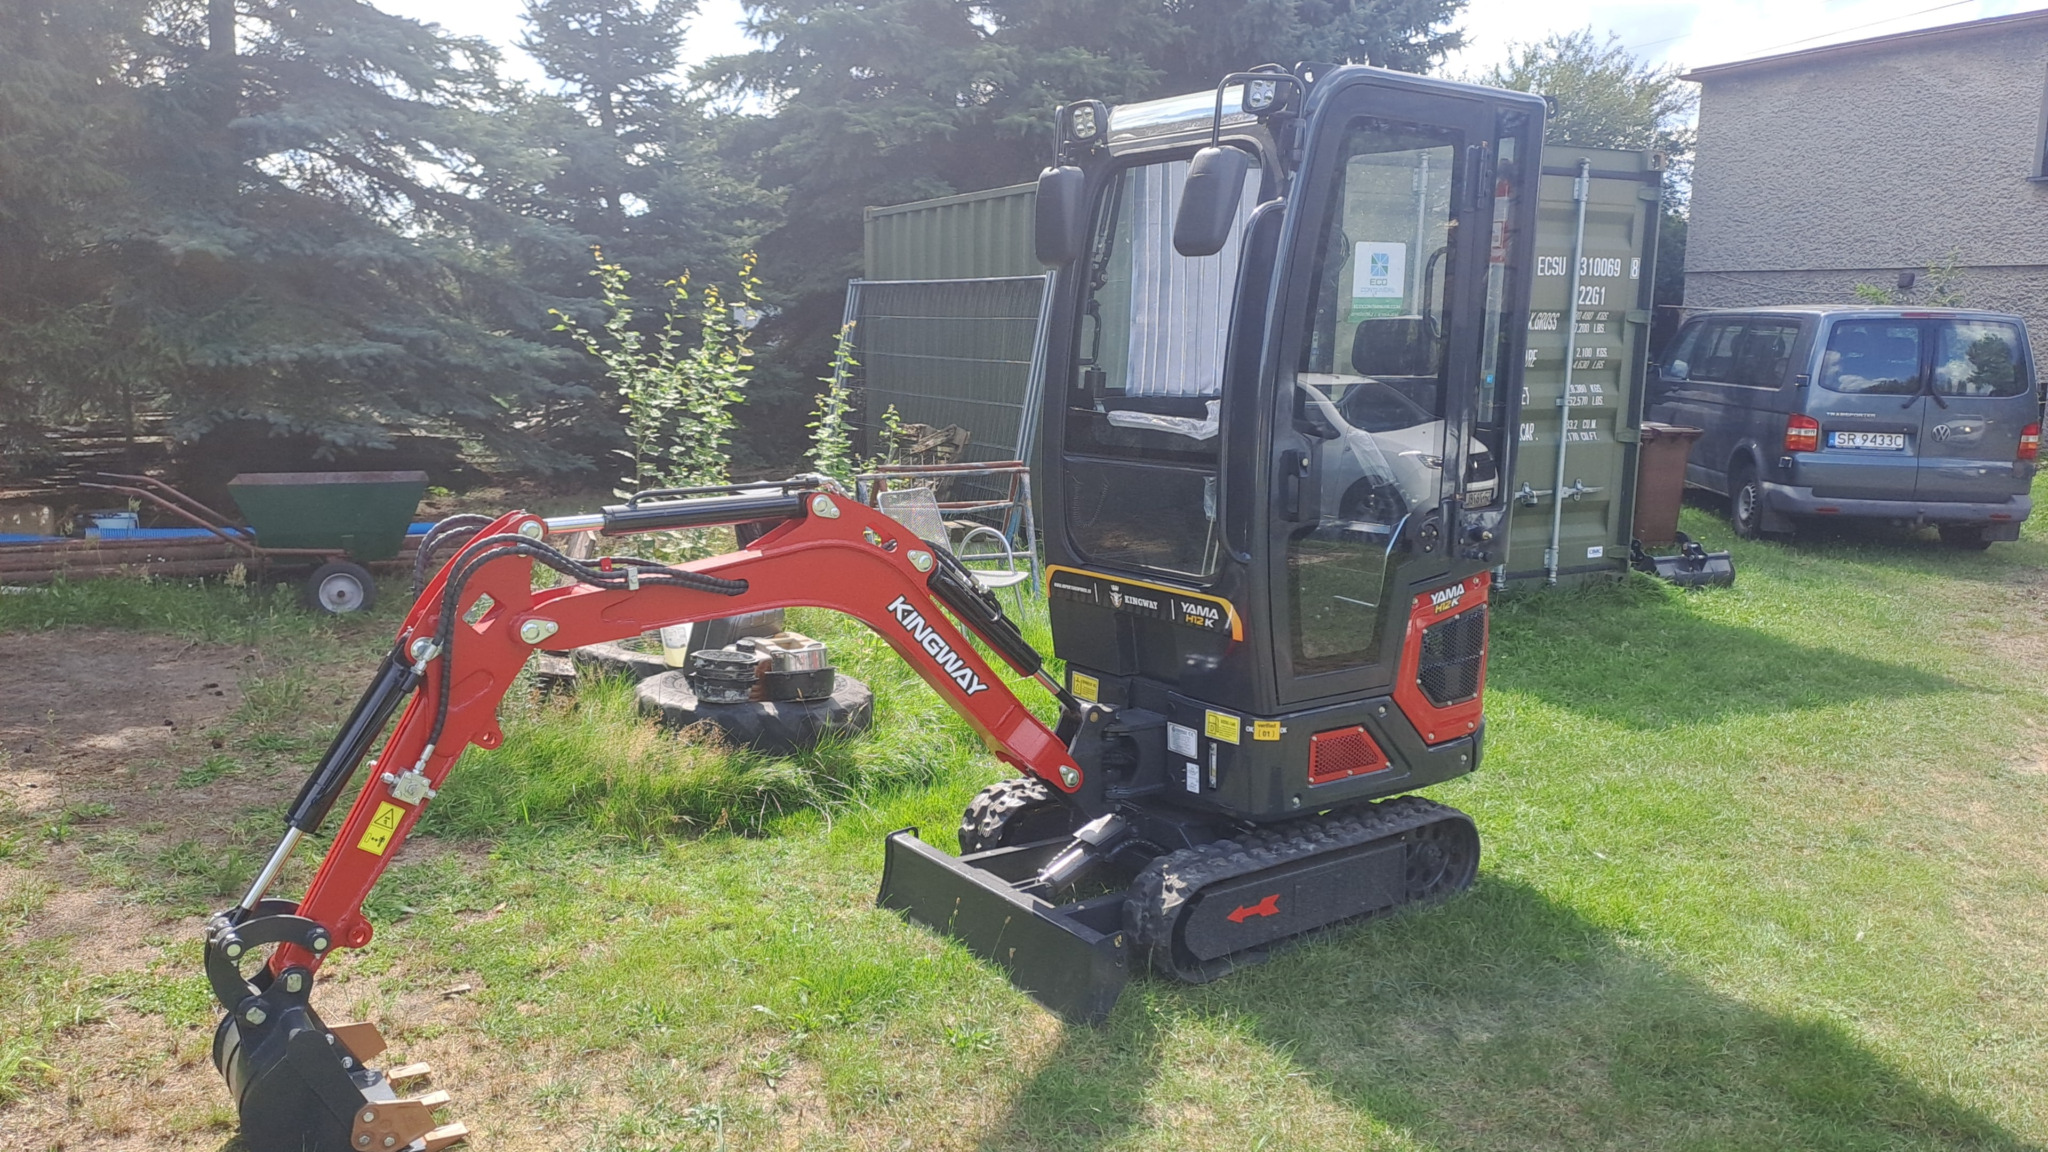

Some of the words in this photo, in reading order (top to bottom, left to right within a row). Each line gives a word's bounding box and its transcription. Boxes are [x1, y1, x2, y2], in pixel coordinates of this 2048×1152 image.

[1537, 256, 1567, 276] ECSU
[1580, 257, 1621, 277] 310069
[1369, 278, 1388, 286] ECO
[1578, 286, 1606, 306] 22G1
[1528, 312, 1560, 331] X.GROSS
[1575, 347, 1593, 358] 2.100
[1837, 433, 1856, 445] SR
[1861, 433, 1903, 447] 9433C
[1124, 595, 1158, 610] KINGWAY
[1430, 583, 1465, 605] YAMA
[1180, 602, 1219, 620] YAMA
[887, 595, 989, 696] KINGWAY
